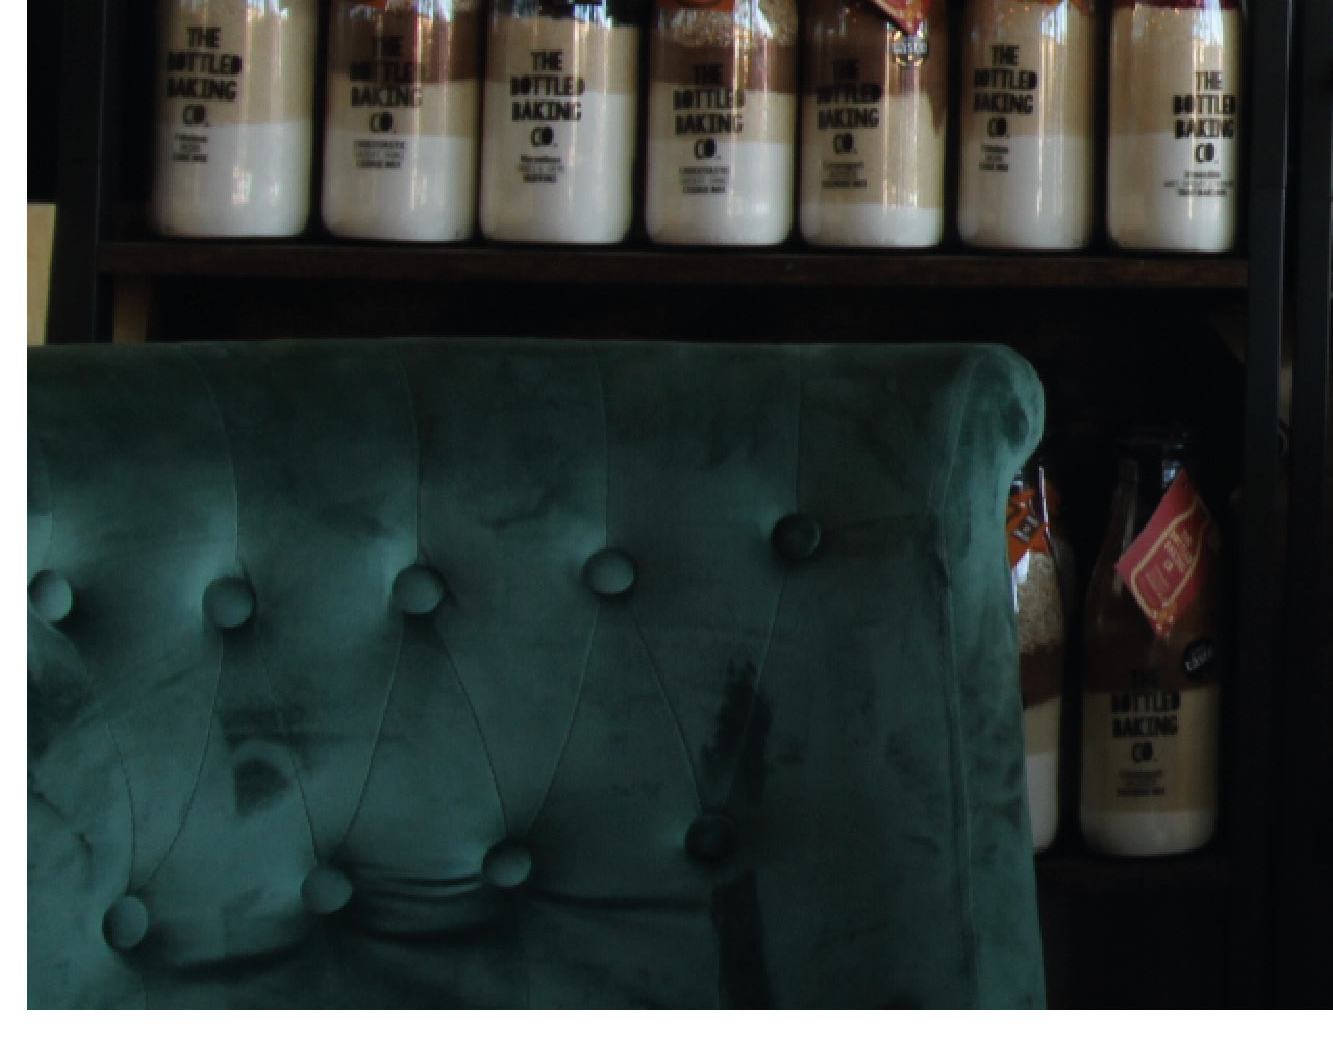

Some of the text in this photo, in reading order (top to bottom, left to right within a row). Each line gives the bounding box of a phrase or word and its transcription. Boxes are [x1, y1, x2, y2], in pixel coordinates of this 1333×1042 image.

[186, 27, 221, 48] THE
[167, 52, 243, 76] BOTTLED
[529, 50, 563, 72] THE
[991, 45, 1020, 67] THE
[692, 63, 723, 85] THE
[832, 58, 859, 80] THE
[973, 69, 1037, 90] BOTTLED
[167, 78, 237, 102] BAKING
[509, 76, 585, 97] BOTTLED
[1194, 70, 1222, 91] THE
[350, 86, 422, 108] BAKING
[672, 88, 745, 111] BOTTLED
[815, 83, 881, 105] BOTTLED
[973, 93, 1034, 115] BAKING
[1172, 94, 1237, 116] BOTTLED
[182, 105, 211, 128] CO.
[510, 101, 582, 123] BAKING
[816, 107, 880, 130] BAKING
[369, 113, 398, 134] CO.
[674, 113, 742, 135] BAKING
[986, 117, 1009, 139] CO.
[1174, 118, 1234, 139] BAKING
[530, 125, 558, 148] CO.
[832, 133, 858, 155] CO.
[693, 138, 721, 161] CO.
[1194, 142, 1219, 164] CO.
[1111, 691, 1180, 713] BOTTLED
[1112, 715, 1179, 738] BAKING
[1132, 742, 1158, 764] CO.
